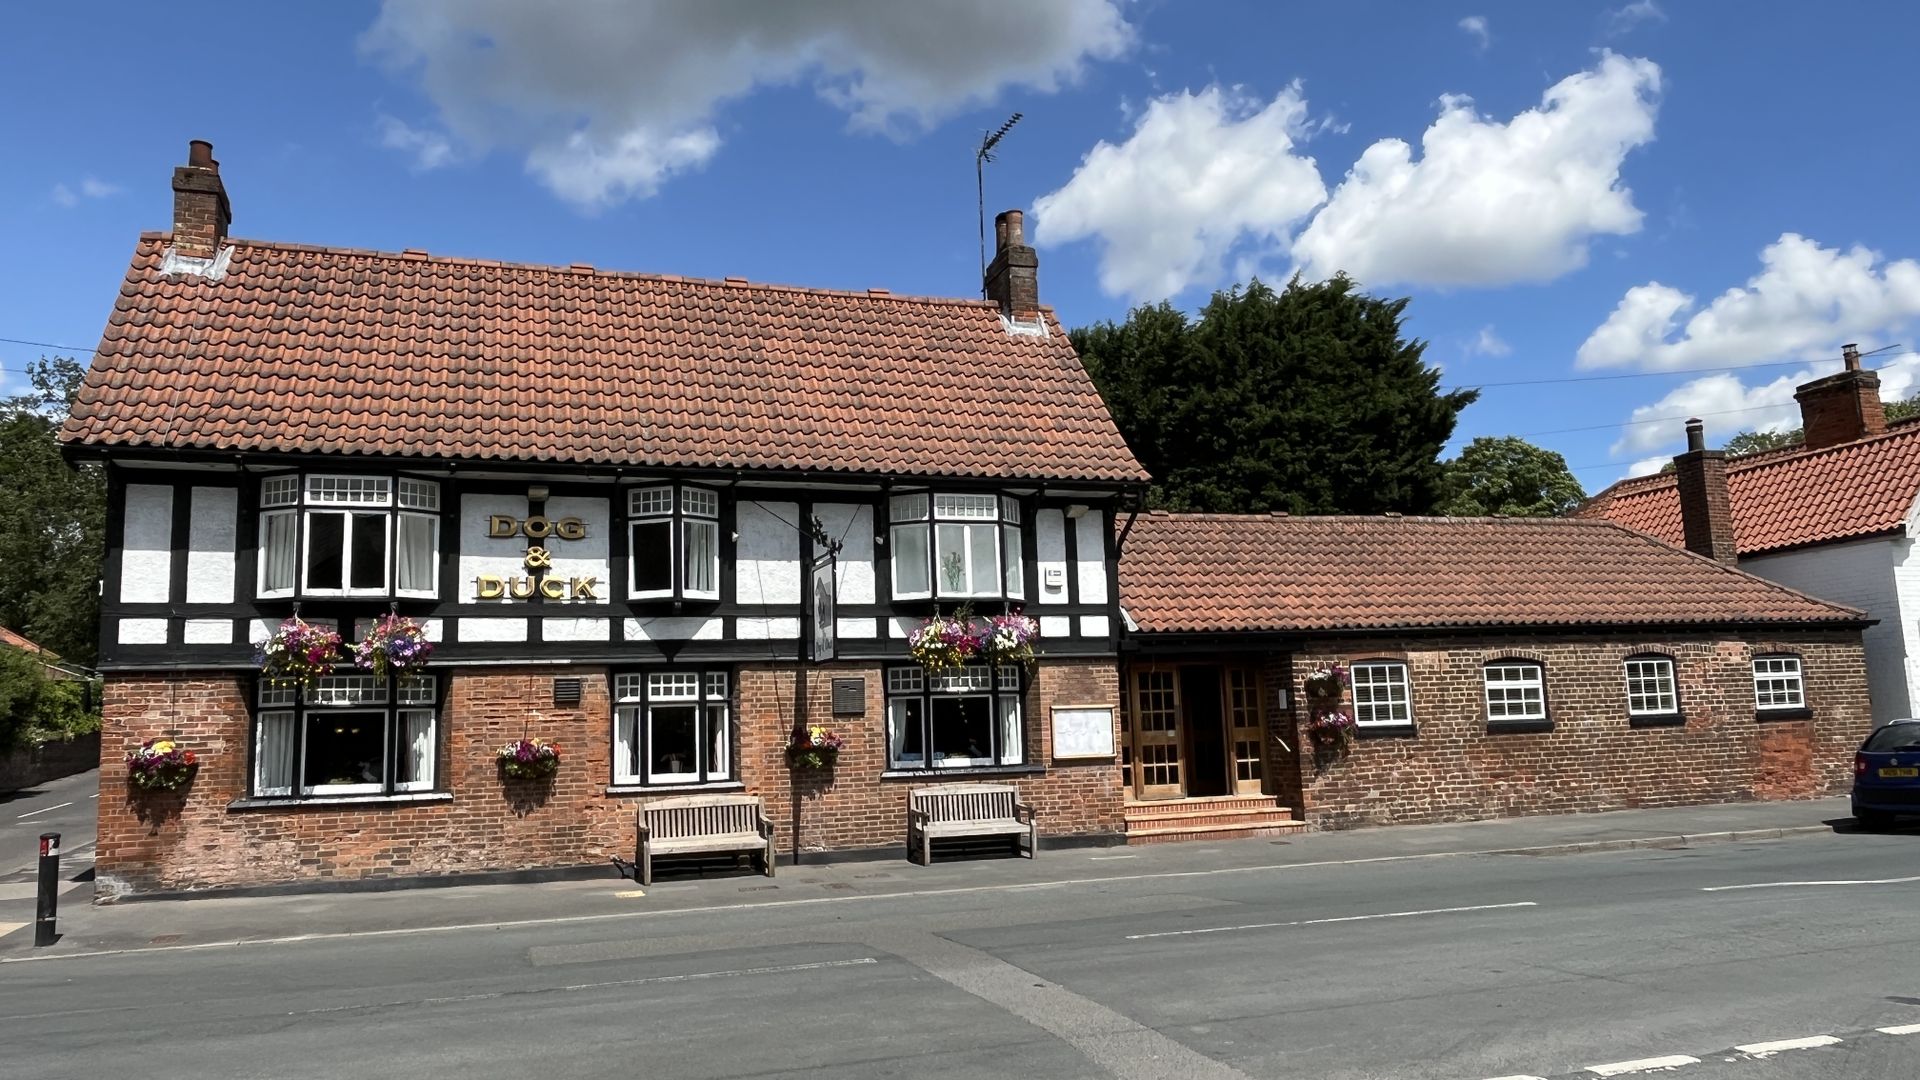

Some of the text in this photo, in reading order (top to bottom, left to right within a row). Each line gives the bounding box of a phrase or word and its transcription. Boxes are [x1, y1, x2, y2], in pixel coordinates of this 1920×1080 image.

[490, 515, 585, 539] DOG
[525, 546, 551, 569] &
[477, 575, 597, 600] DUCK
